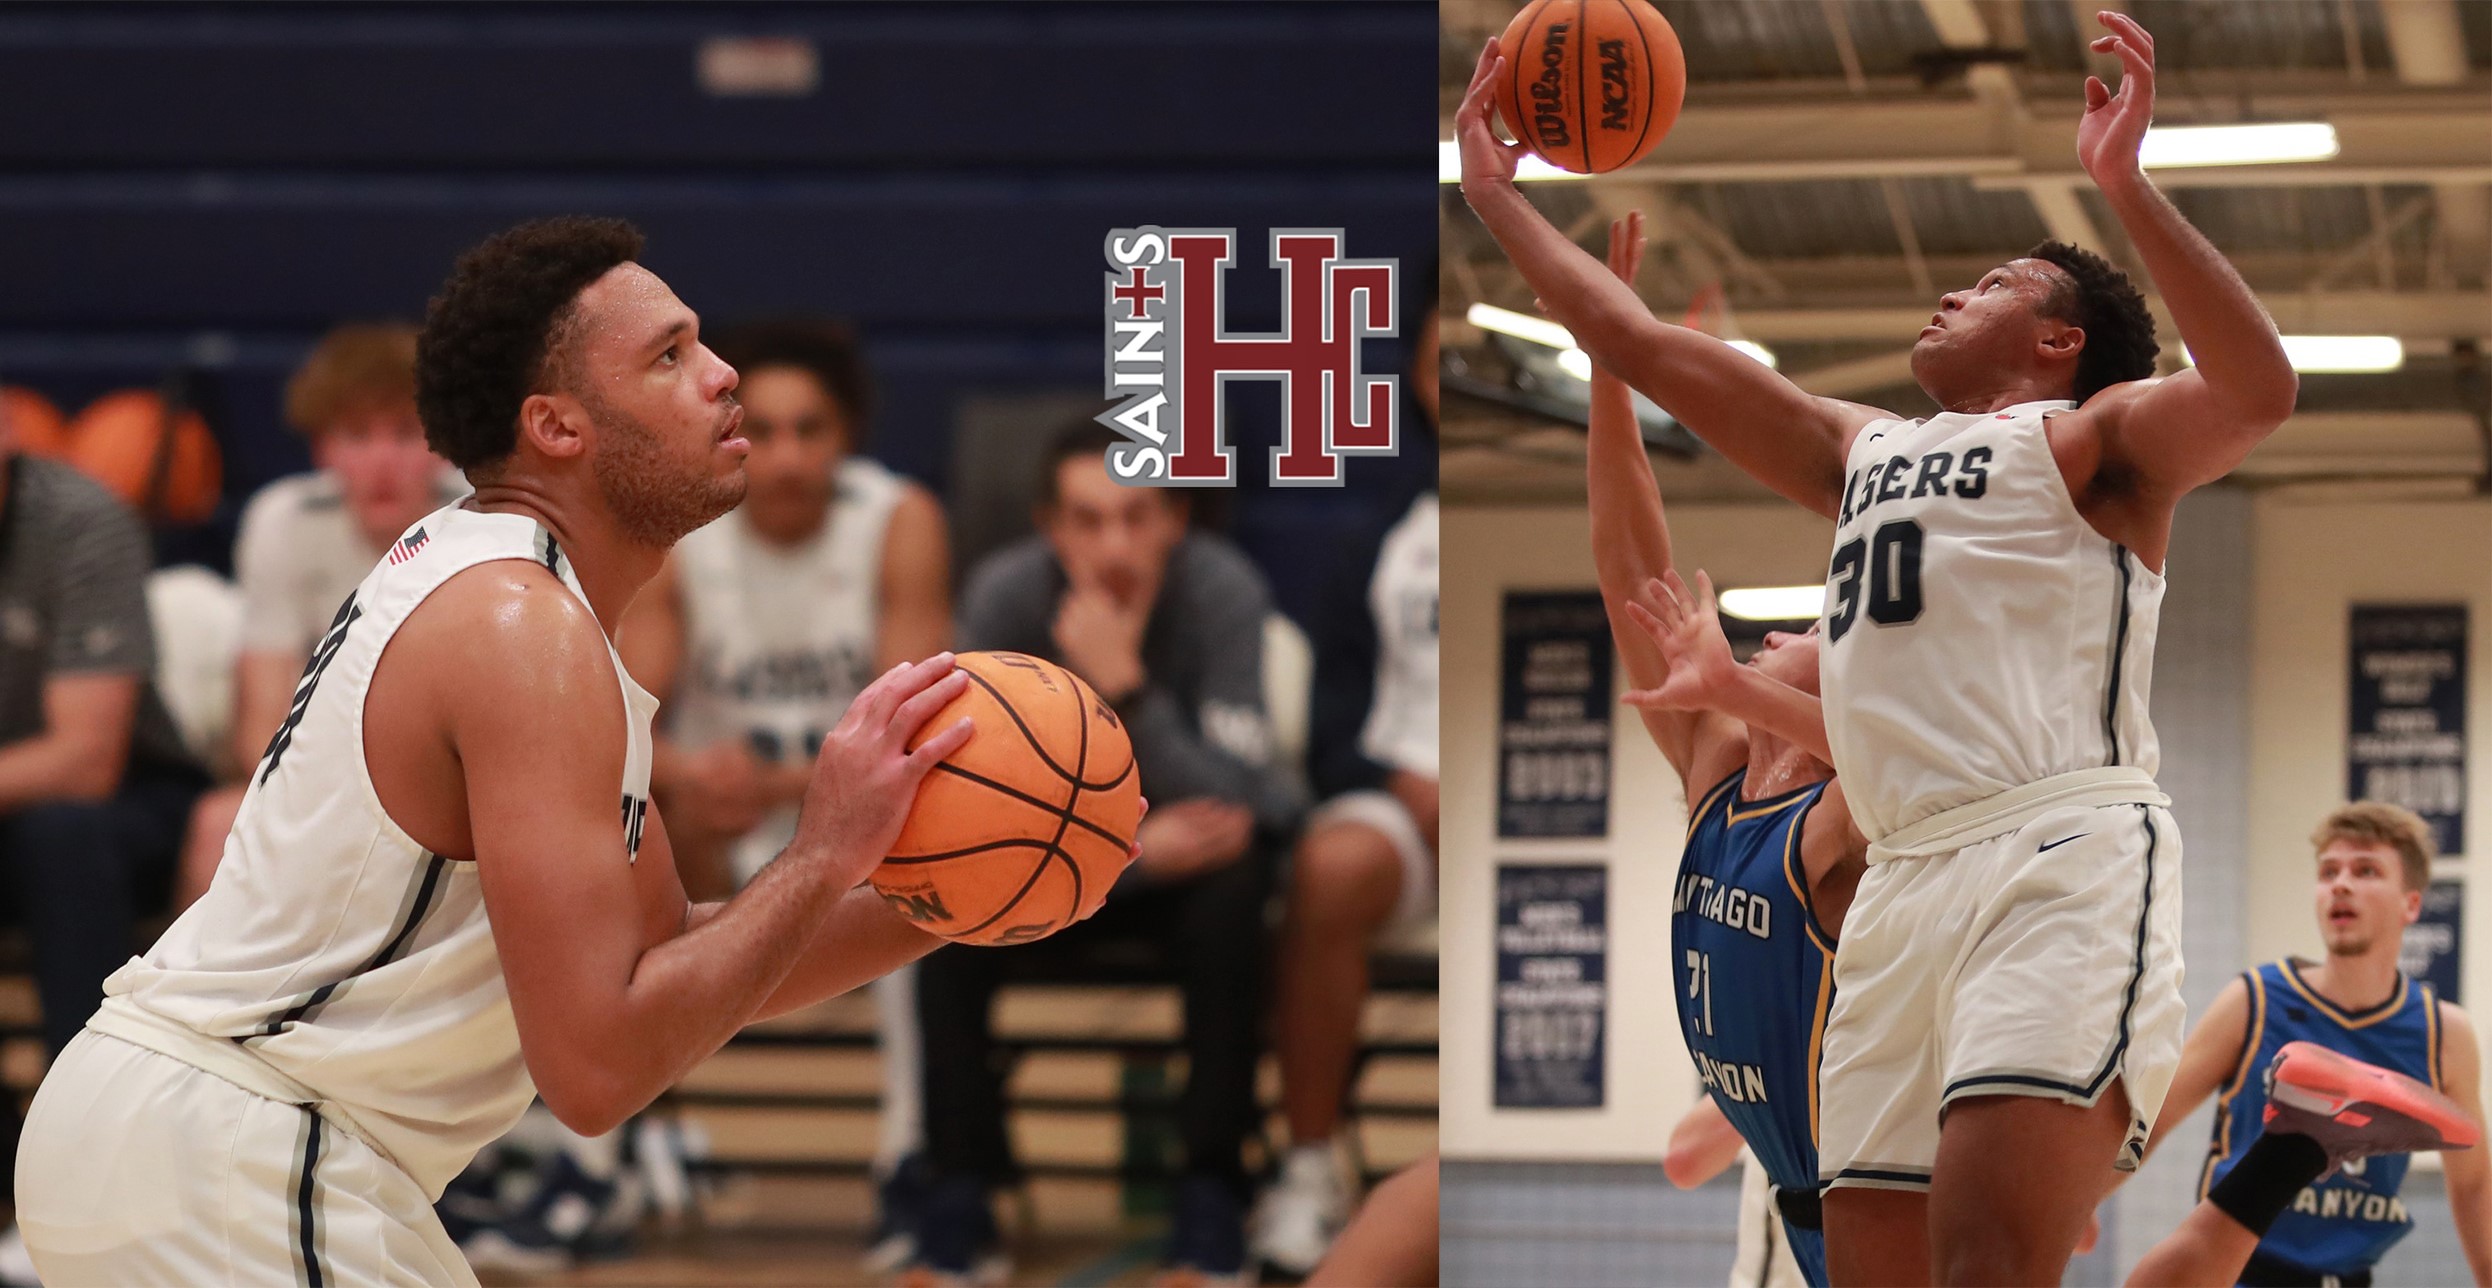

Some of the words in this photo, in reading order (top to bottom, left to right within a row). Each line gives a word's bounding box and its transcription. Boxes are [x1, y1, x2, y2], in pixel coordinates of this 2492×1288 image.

[1530, 23, 1571, 149] Wilson
[1597, 37, 1629, 132] NCAA
[1838, 445, 1994, 530] ASERS
[1829, 516, 1926, 647] 30
[2293, 1185, 2408, 1224] ANYON
